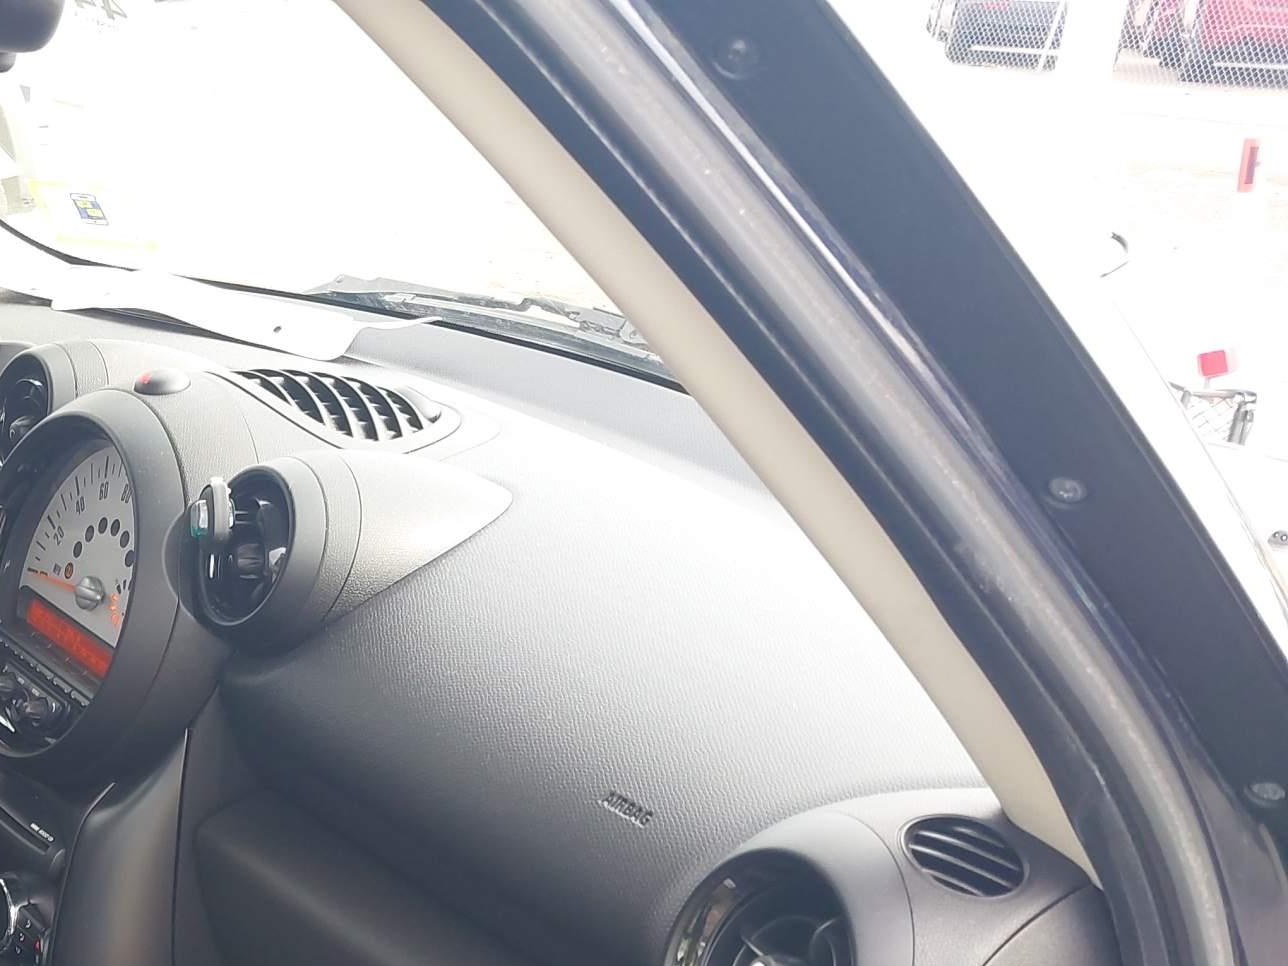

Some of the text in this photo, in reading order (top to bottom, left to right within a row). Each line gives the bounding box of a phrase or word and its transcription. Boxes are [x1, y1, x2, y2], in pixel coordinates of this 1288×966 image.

[99, 481, 109, 501] 60
[75, 496, 85, 515] 40
[53, 525, 64, 546] 20
